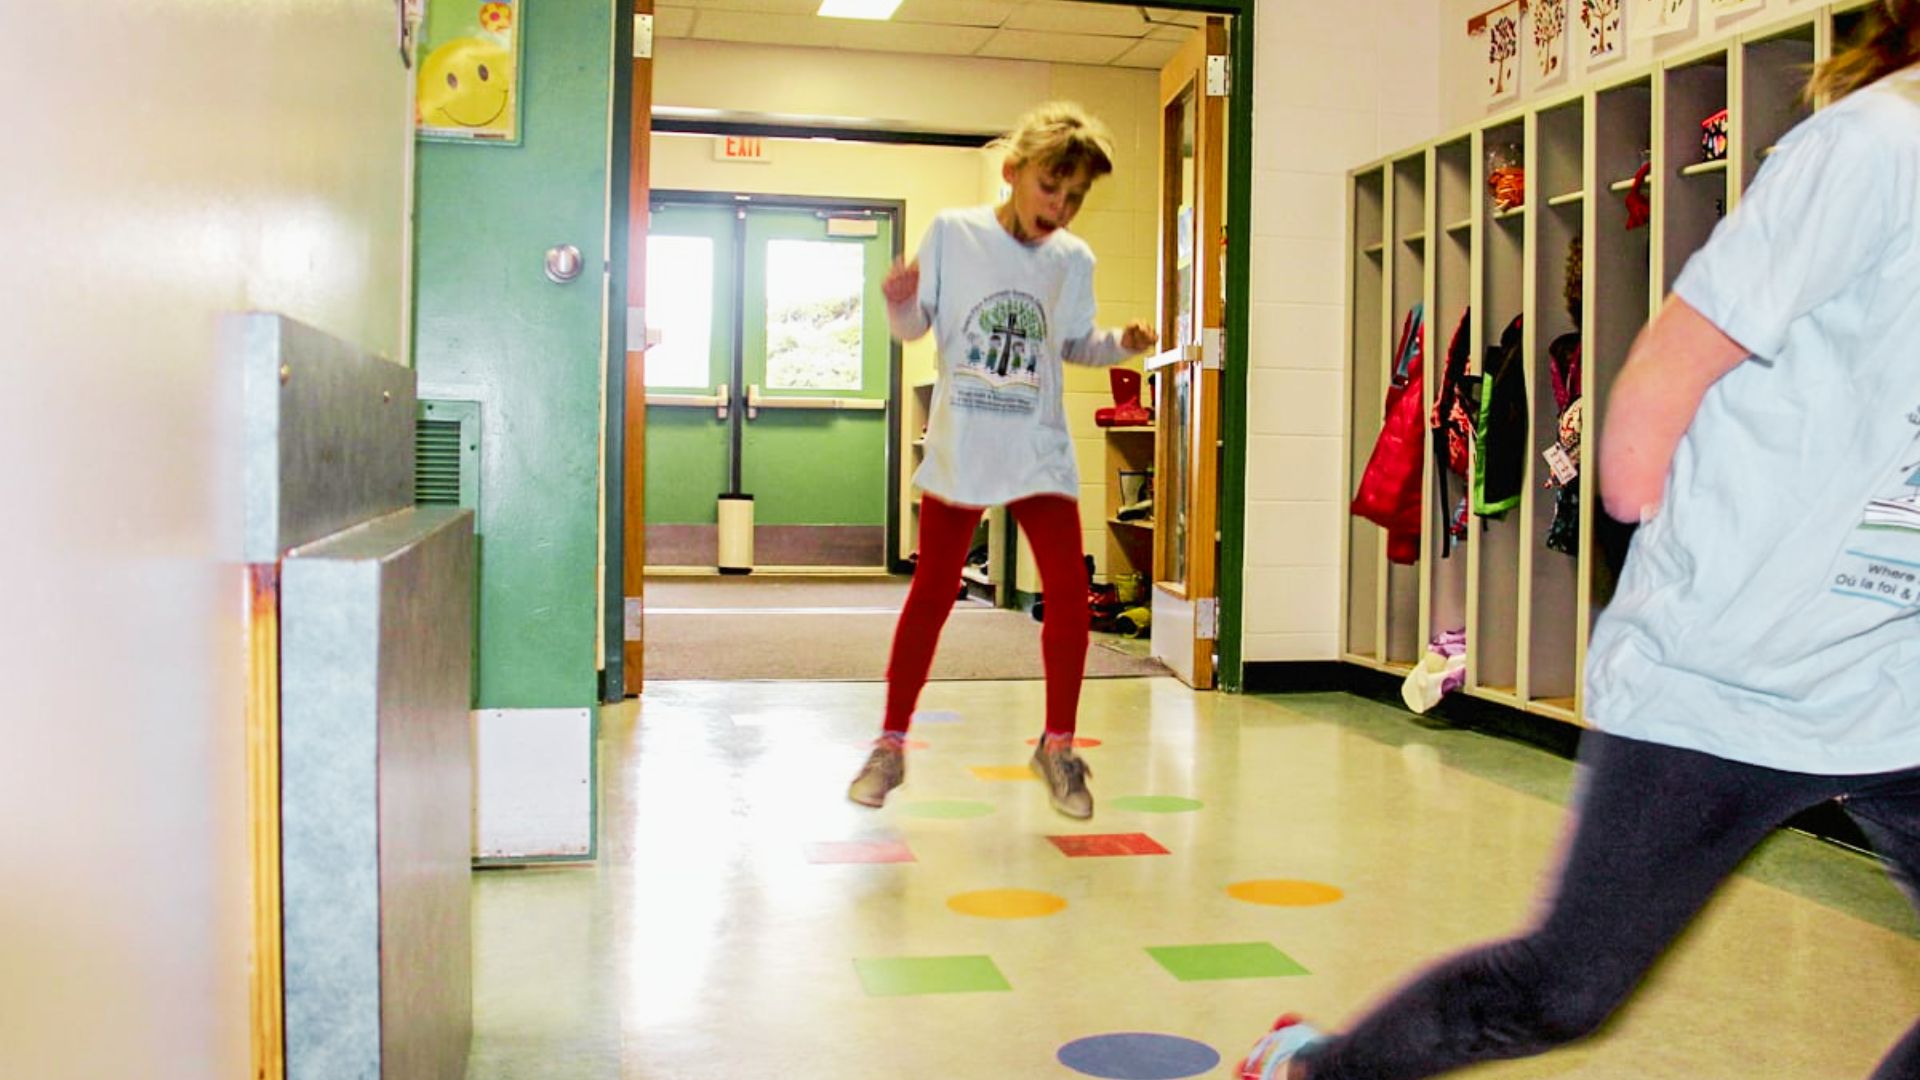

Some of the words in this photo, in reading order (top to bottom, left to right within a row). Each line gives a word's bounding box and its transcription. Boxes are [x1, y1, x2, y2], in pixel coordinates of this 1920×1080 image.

[1868, 564, 1915, 581] Where
[1860, 578, 1873, 590] la
[1878, 582, 1897, 595] foi
[1901, 588, 1911, 600] &
